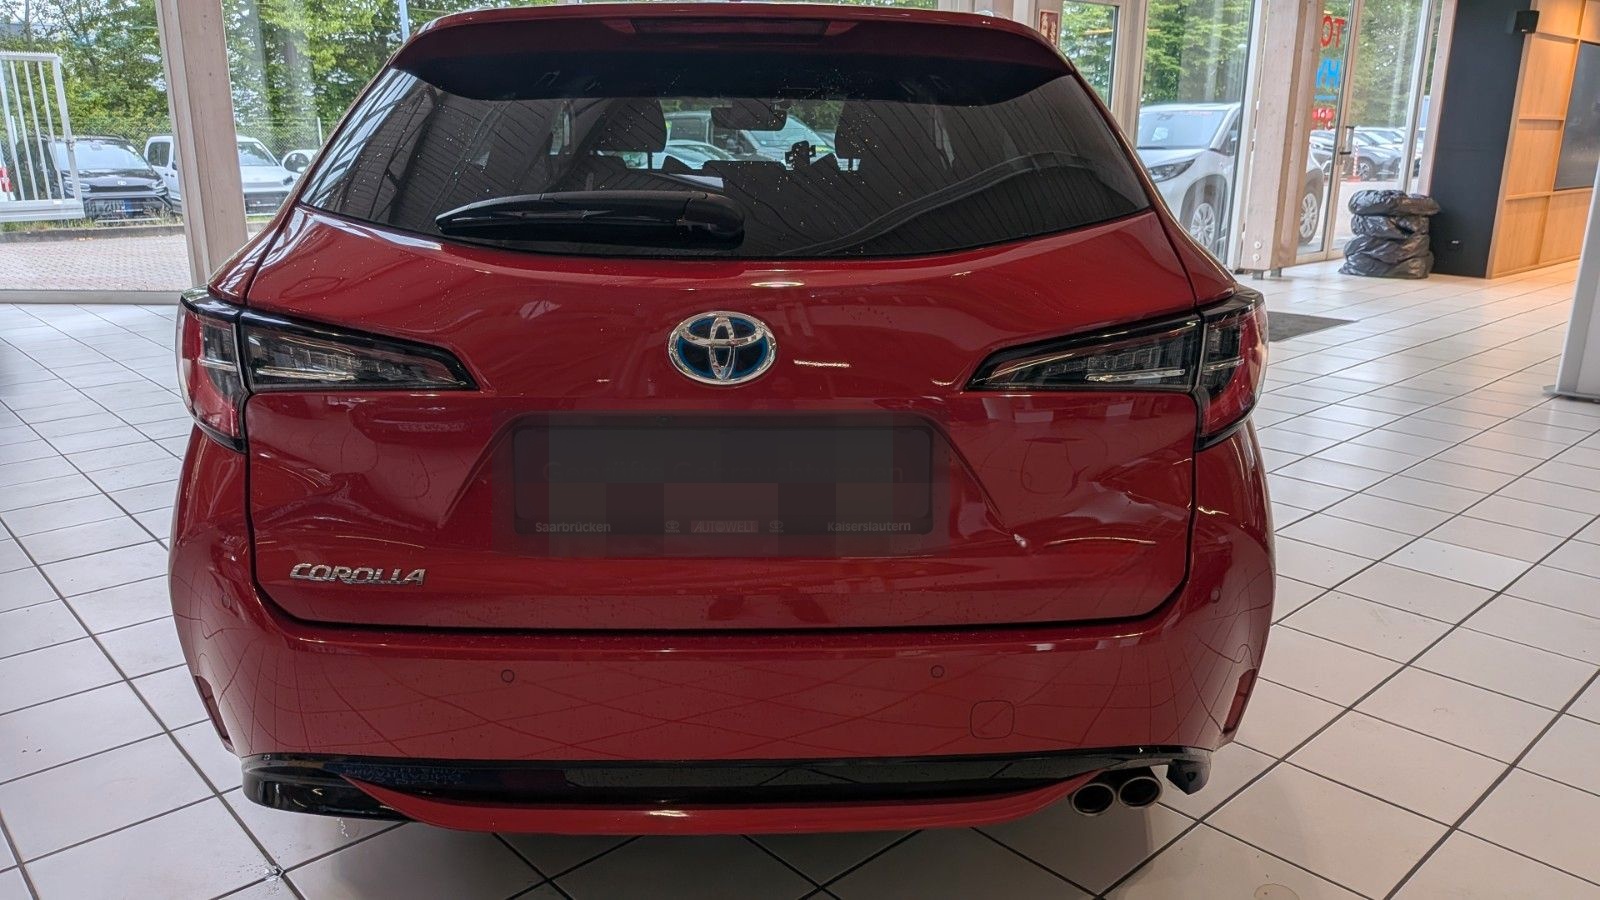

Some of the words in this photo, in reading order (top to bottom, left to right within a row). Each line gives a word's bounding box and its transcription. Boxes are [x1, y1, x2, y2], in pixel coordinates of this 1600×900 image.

[535, 521, 611, 533] Saarbrücken
[692, 520, 756, 533] AUTOWELT
[827, 521, 911, 533] Kaiserslautern
[289, 562, 426, 586] COROLLA
